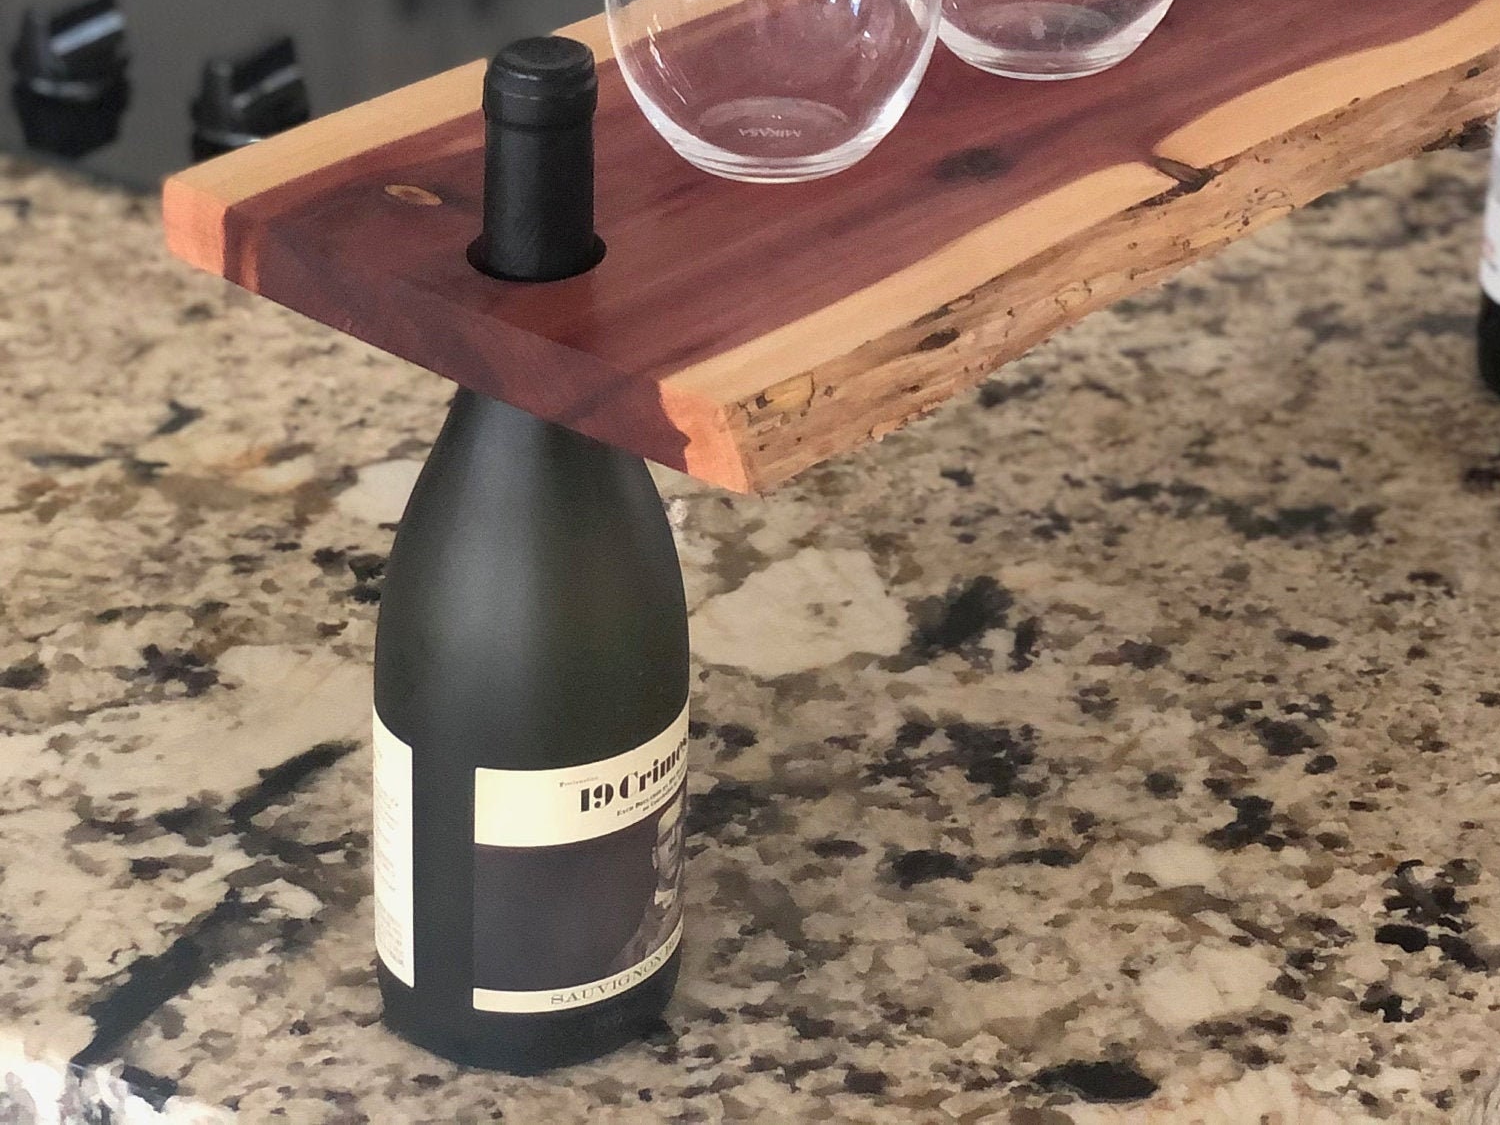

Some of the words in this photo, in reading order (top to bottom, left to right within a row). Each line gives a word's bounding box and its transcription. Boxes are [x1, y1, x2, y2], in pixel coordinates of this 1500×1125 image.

[738, 127, 802, 138] MIKASA
[580, 783, 615, 813] 19
[550, 956, 663, 1005] SAUVIGNON
